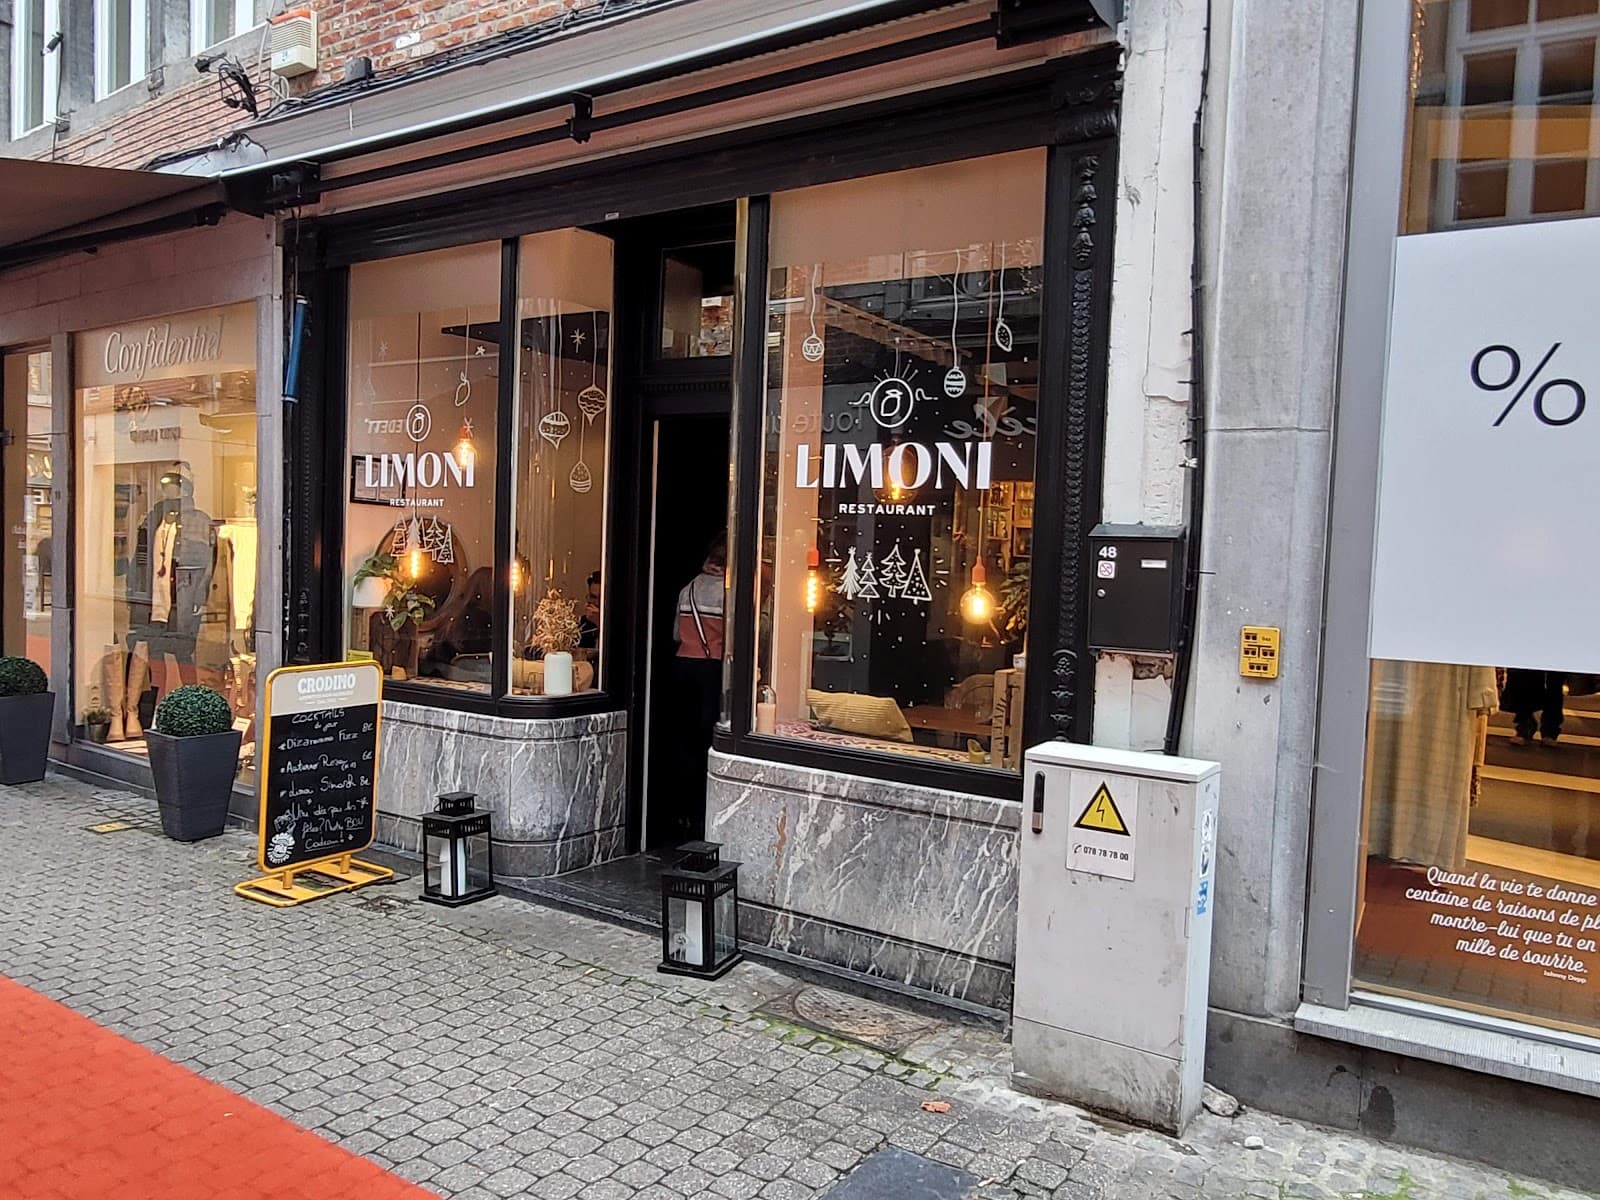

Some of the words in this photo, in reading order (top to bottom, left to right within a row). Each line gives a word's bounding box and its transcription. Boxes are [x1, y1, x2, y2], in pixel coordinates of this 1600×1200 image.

[104, 315, 224, 381] Confidentiel
[1470, 341, 1586, 428] %
[364, 451, 475, 489] LIMONI
[795, 440, 993, 490] LIMONI
[389, 497, 445, 507] RESTAURANT
[838, 503, 937, 517] RESTAURANT
[1098, 546, 1118, 559] 48
[297, 673, 356, 694] CRODINO
[292, 708, 345, 724] COCKTAILS
[1083, 846, 1097, 856] 078
[1098, 848, 1107, 857] 78
[1109, 850, 1118, 859] 78
[1119, 852, 1129, 861] 00
[1426, 866, 1477, 887] Quand
[1480, 874, 1497, 891] la
[1500, 878, 1524, 895] vie
[1526, 882, 1544, 898] te
[1546, 884, 1598, 907] donne
[1405, 886, 1469, 909] centaine
[1472, 895, 1492, 912] de
[1496, 899, 1556, 923] raisons
[1558, 908, 1580, 927] de
[1430, 911, 1520, 939] montre-lui
[1522, 928, 1553, 945] que
[1556, 932, 1573, 948] tu
[1576, 937, 1596, 953] en
[1455, 938, 1497, 957] mille
[1499, 944, 1520, 961] de
[1522, 949, 1589, 975] sourire.
